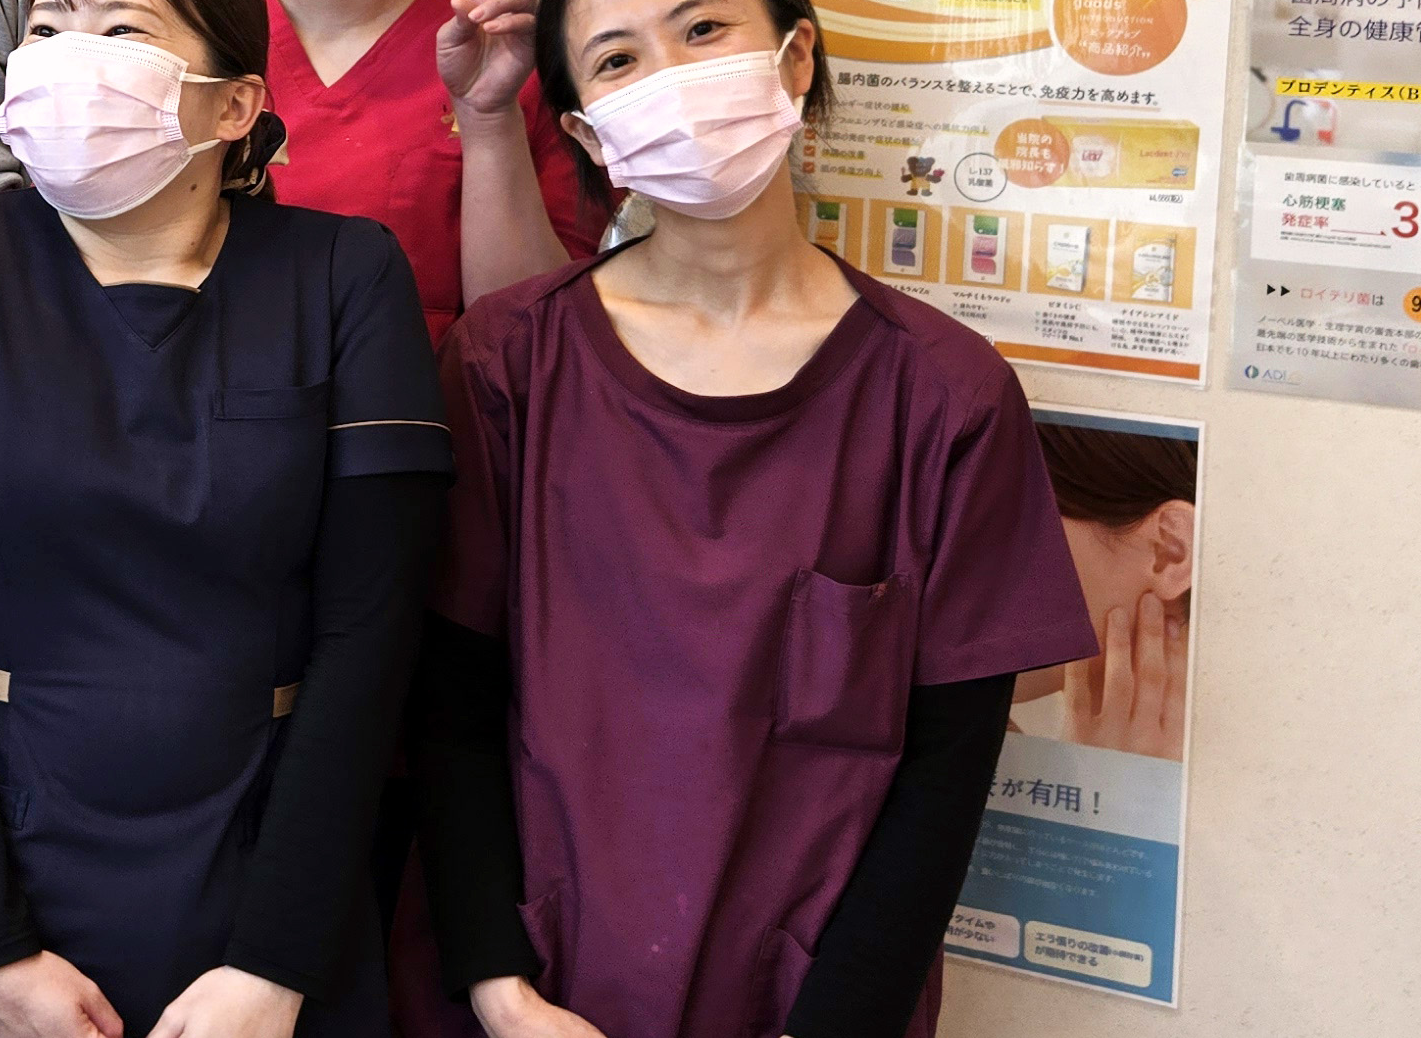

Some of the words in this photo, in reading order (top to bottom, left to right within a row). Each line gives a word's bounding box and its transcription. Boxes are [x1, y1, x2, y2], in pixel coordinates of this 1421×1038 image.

[1288, 15, 1421, 43] 全身の健康
[1283, 193, 1347, 212] 心筋梗塞
[1281, 212, 1330, 229] 発症率
